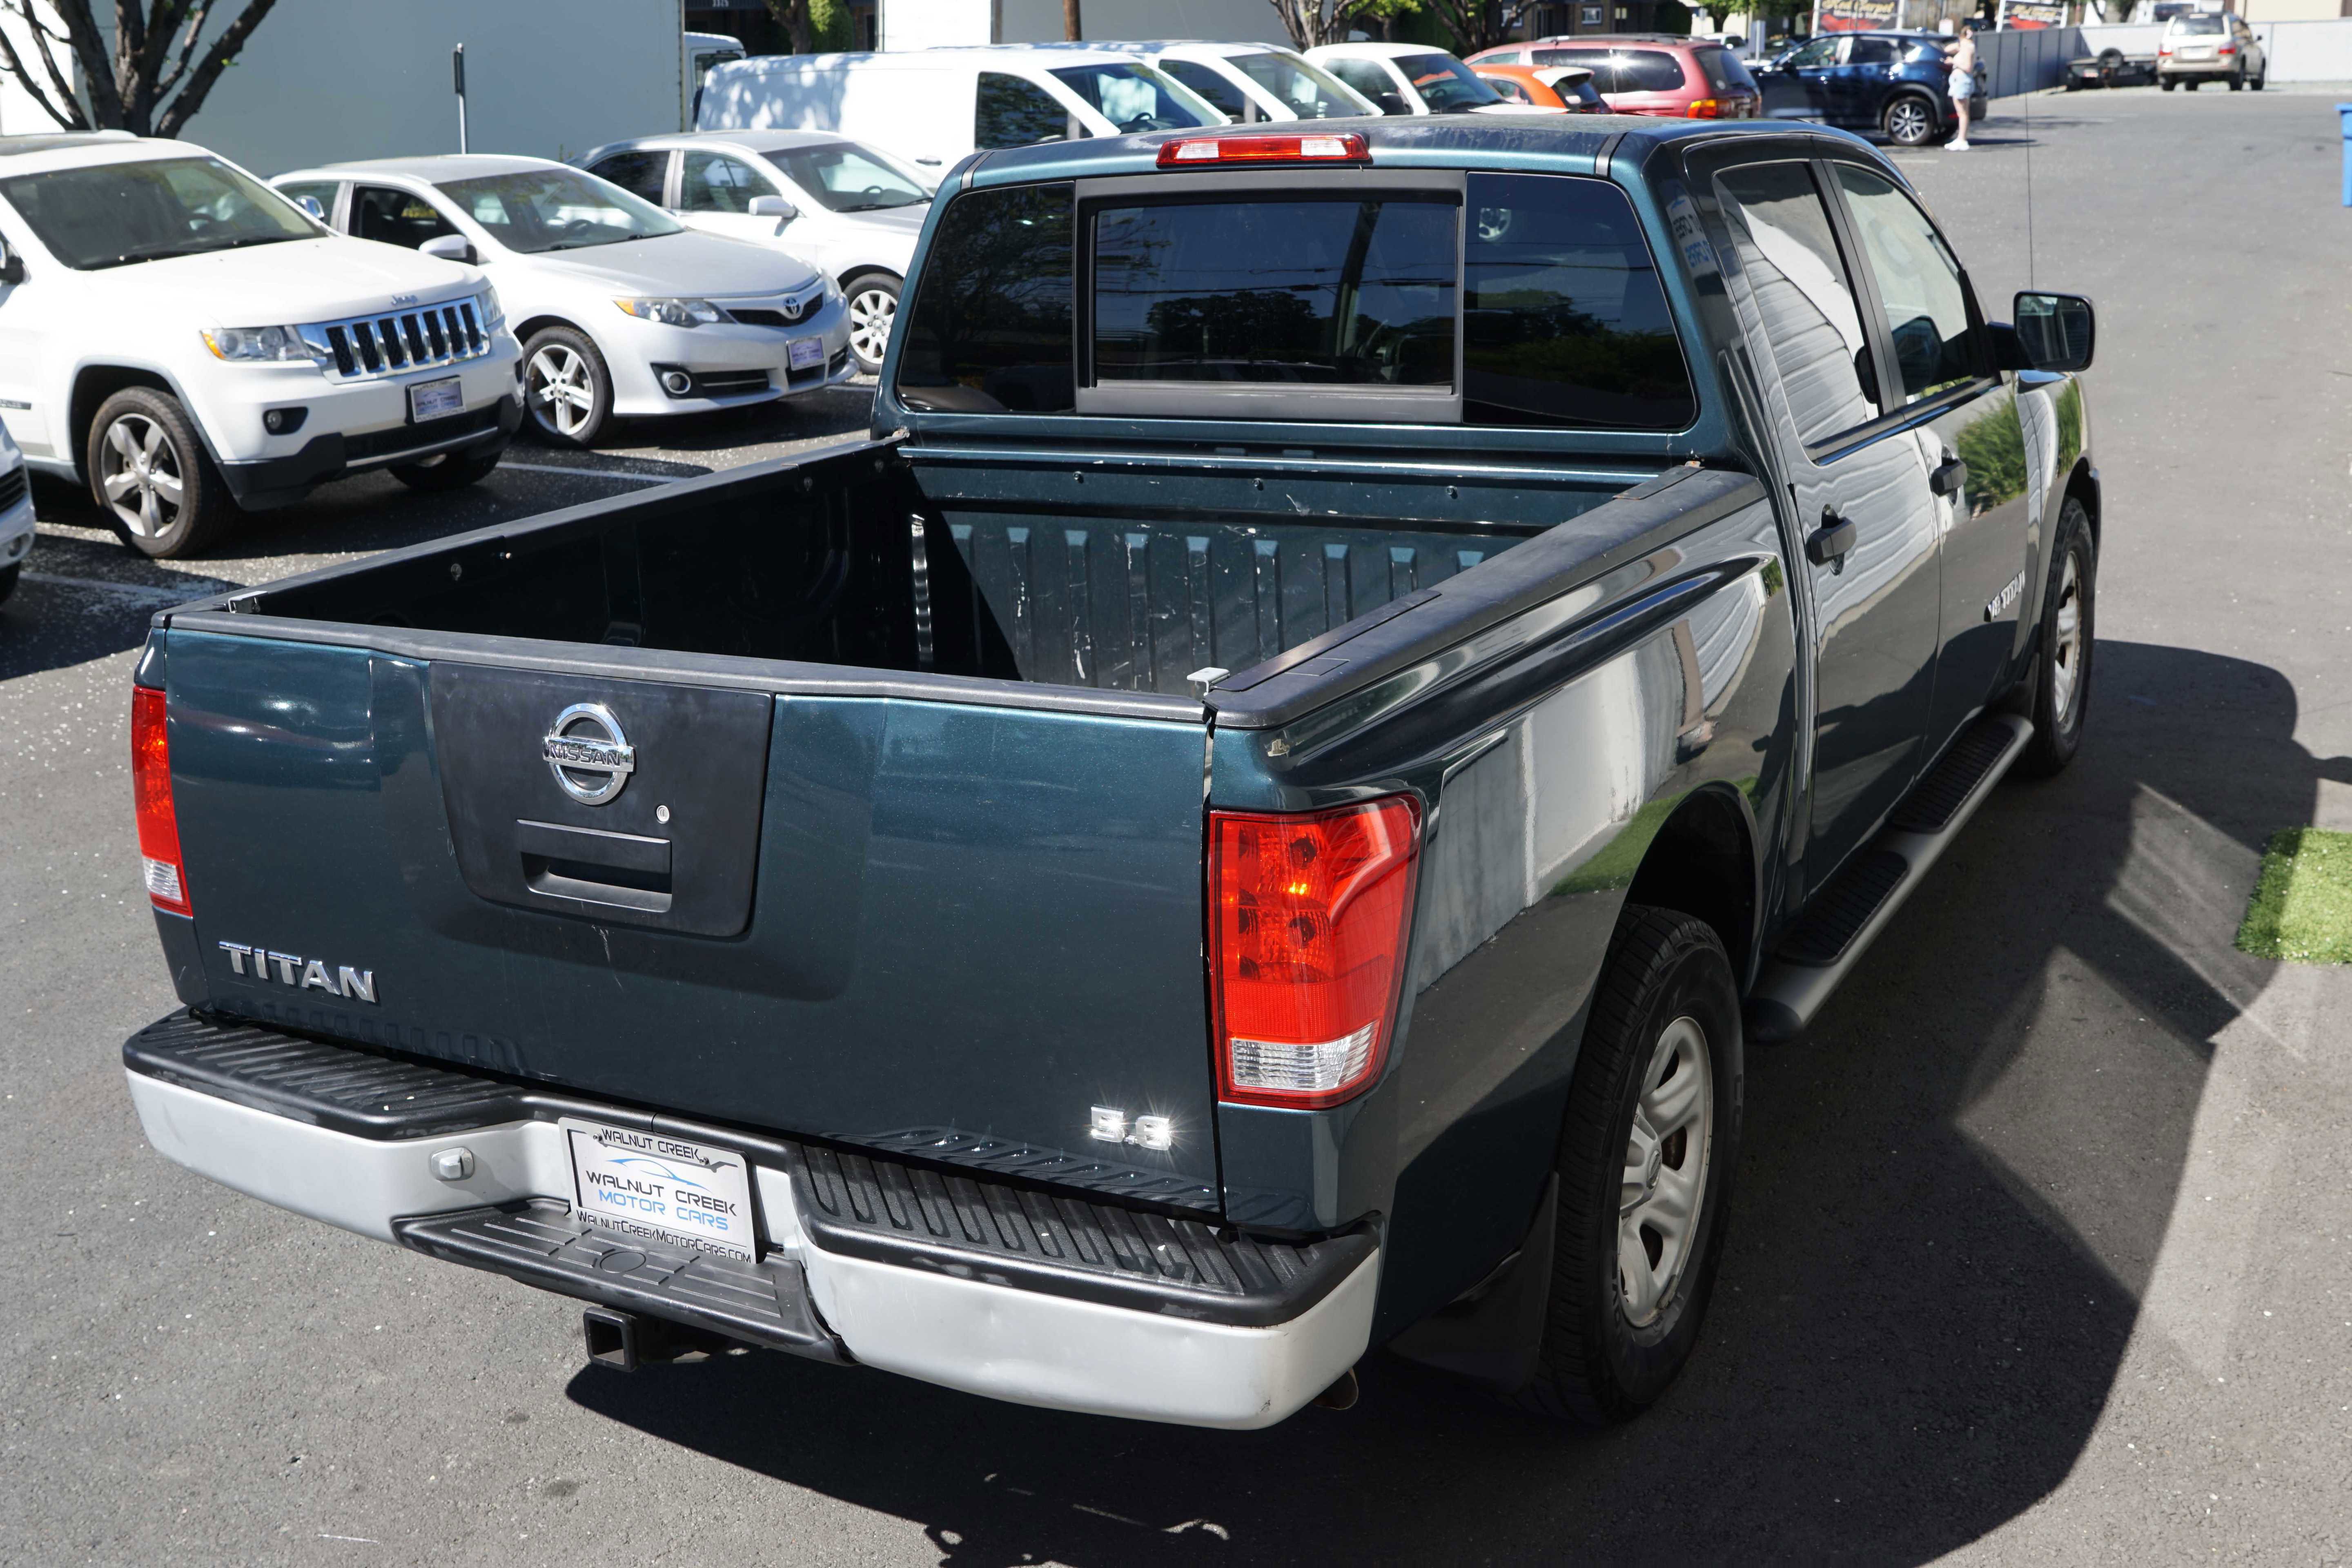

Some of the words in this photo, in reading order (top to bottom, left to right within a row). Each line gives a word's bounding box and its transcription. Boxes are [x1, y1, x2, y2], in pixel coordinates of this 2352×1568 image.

[2000, 570, 2025, 609] TITAN
[549, 744, 621, 768] NISSAN
[219, 941, 377, 1003] TITAN
[601, 1128, 653, 1150] WALNUT
[658, 1141, 700, 1160] CREEK
[1090, 1104, 1171, 1151] 5.6
[586, 1170, 664, 1198] WALNUT
[675, 1189, 737, 1217] CREEK
[598, 1189, 666, 1215] MOTOR
[676, 1207, 728, 1231] CARS
